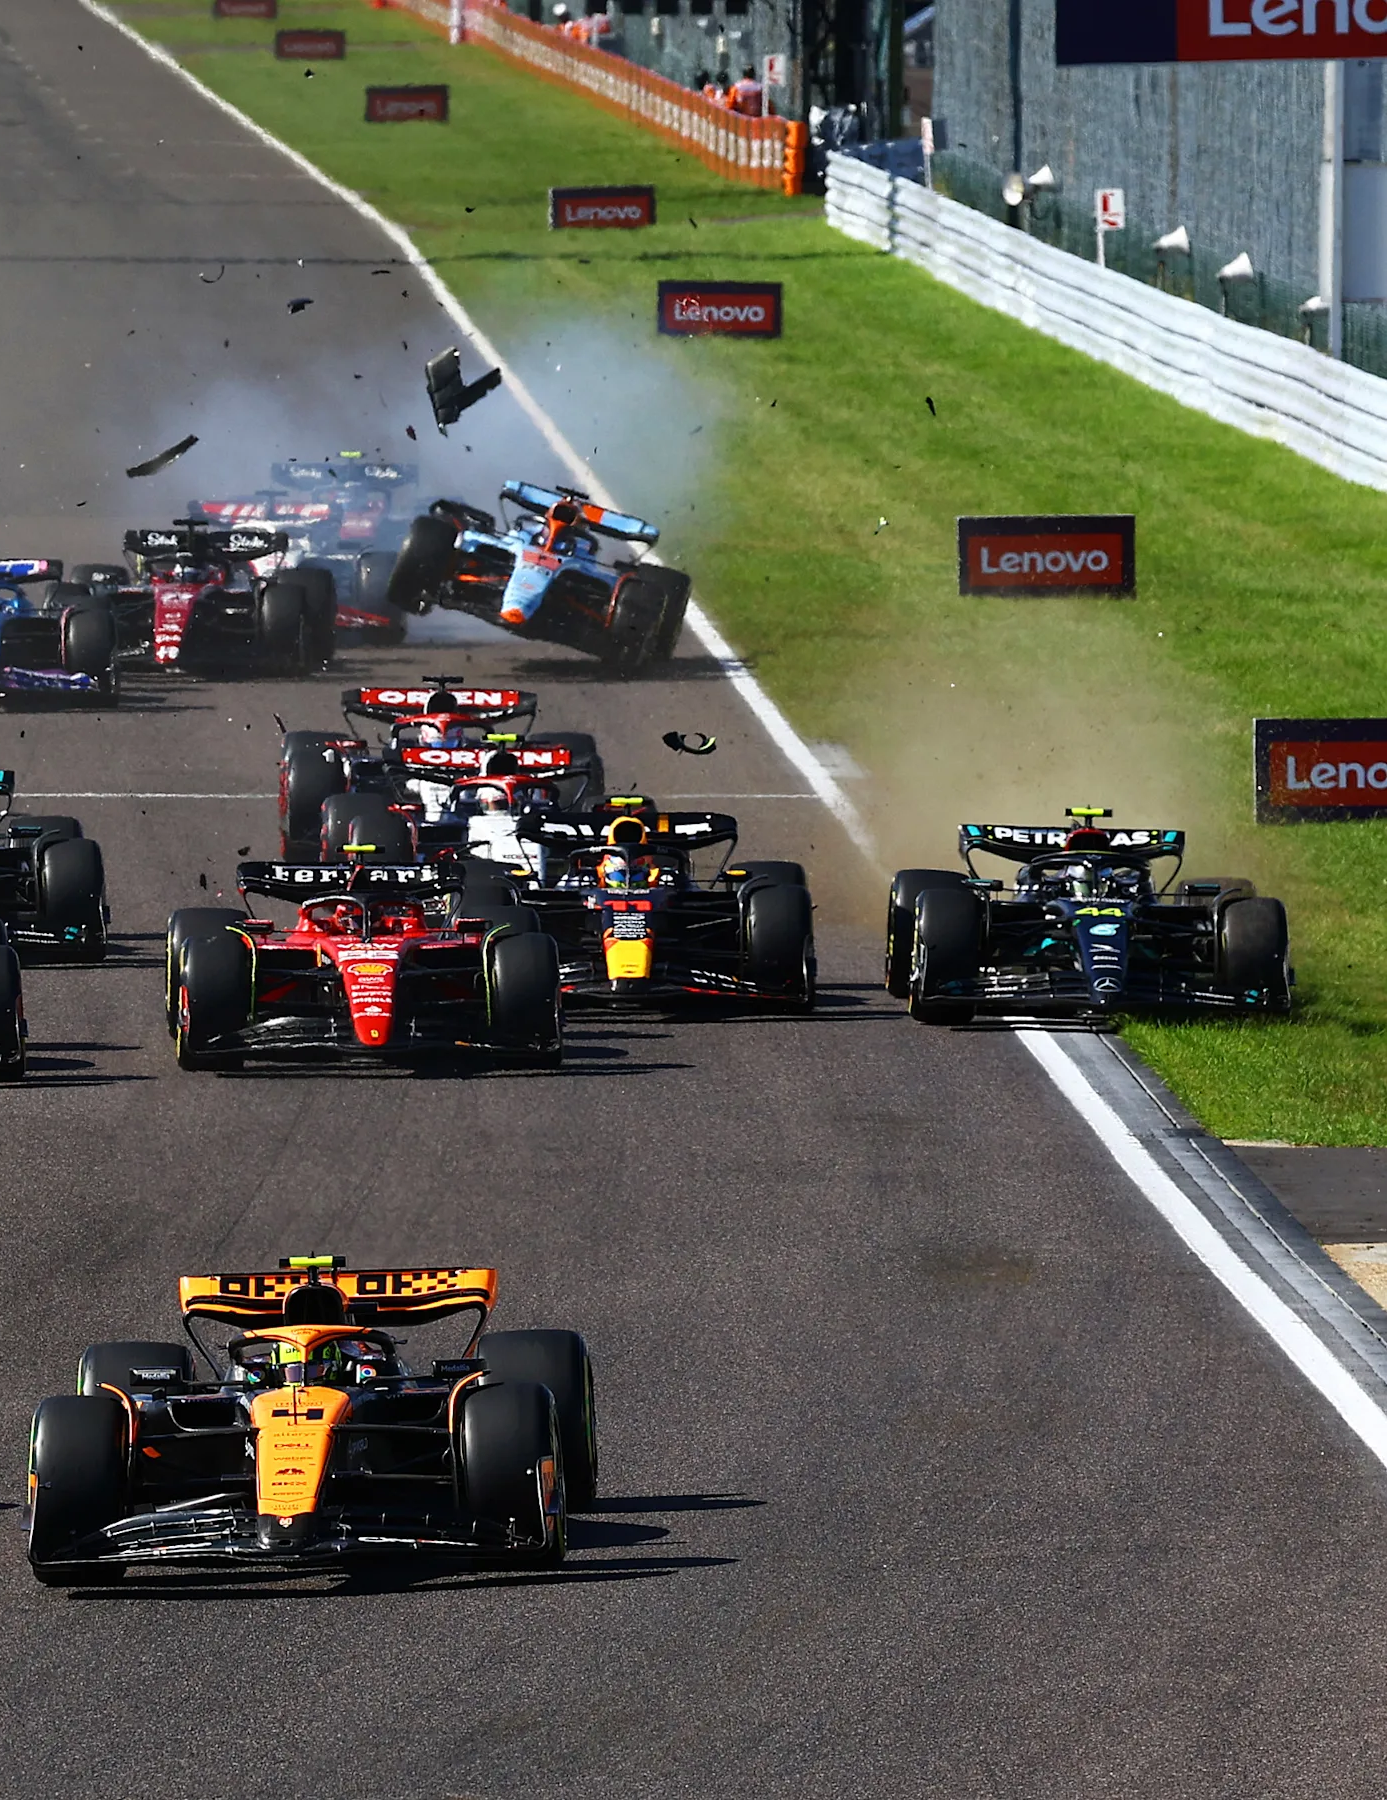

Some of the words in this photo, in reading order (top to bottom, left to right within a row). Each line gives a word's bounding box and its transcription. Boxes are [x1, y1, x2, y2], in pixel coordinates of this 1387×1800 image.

[565, 204, 642, 222] Lenovo
[674, 303, 766, 323] Lenovo
[980, 546, 1110, 575] Lenovo
[377, 690, 502, 705] OREN
[418, 750, 553, 765] ORN
[993, 827, 1152, 846] PETRAS
[603, 900, 653, 911] 11
[1074, 907, 1126, 917] 44
